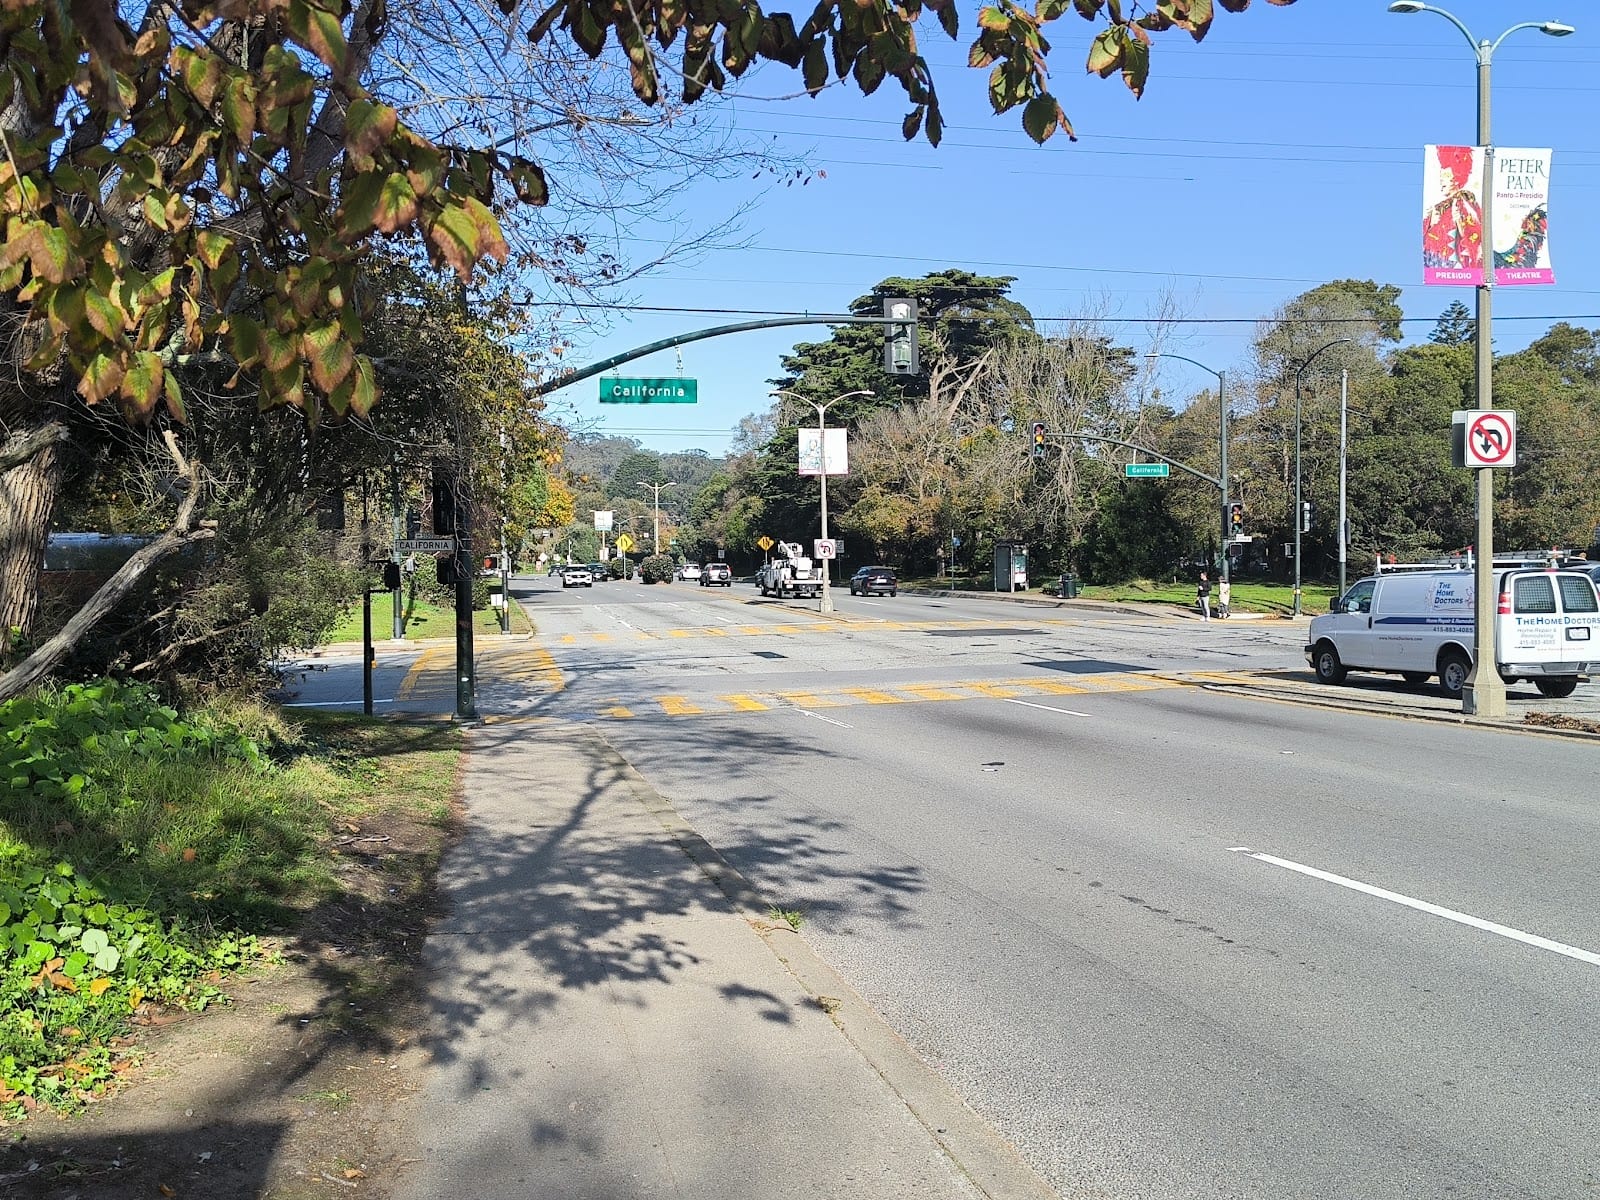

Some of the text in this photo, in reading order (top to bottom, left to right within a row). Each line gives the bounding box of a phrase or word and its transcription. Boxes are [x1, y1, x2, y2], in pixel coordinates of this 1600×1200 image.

[1500, 158, 1549, 179] PETER
[1507, 175, 1535, 190] PAN
[1435, 271, 1472, 280] PRESIDIO
[1505, 271, 1542, 279] THEATRE
[612, 385, 685, 397] California
[399, 541, 449, 550] CALIFORNIA
[1515, 617, 1535, 625] THE
[1536, 617, 1563, 625] HOME
